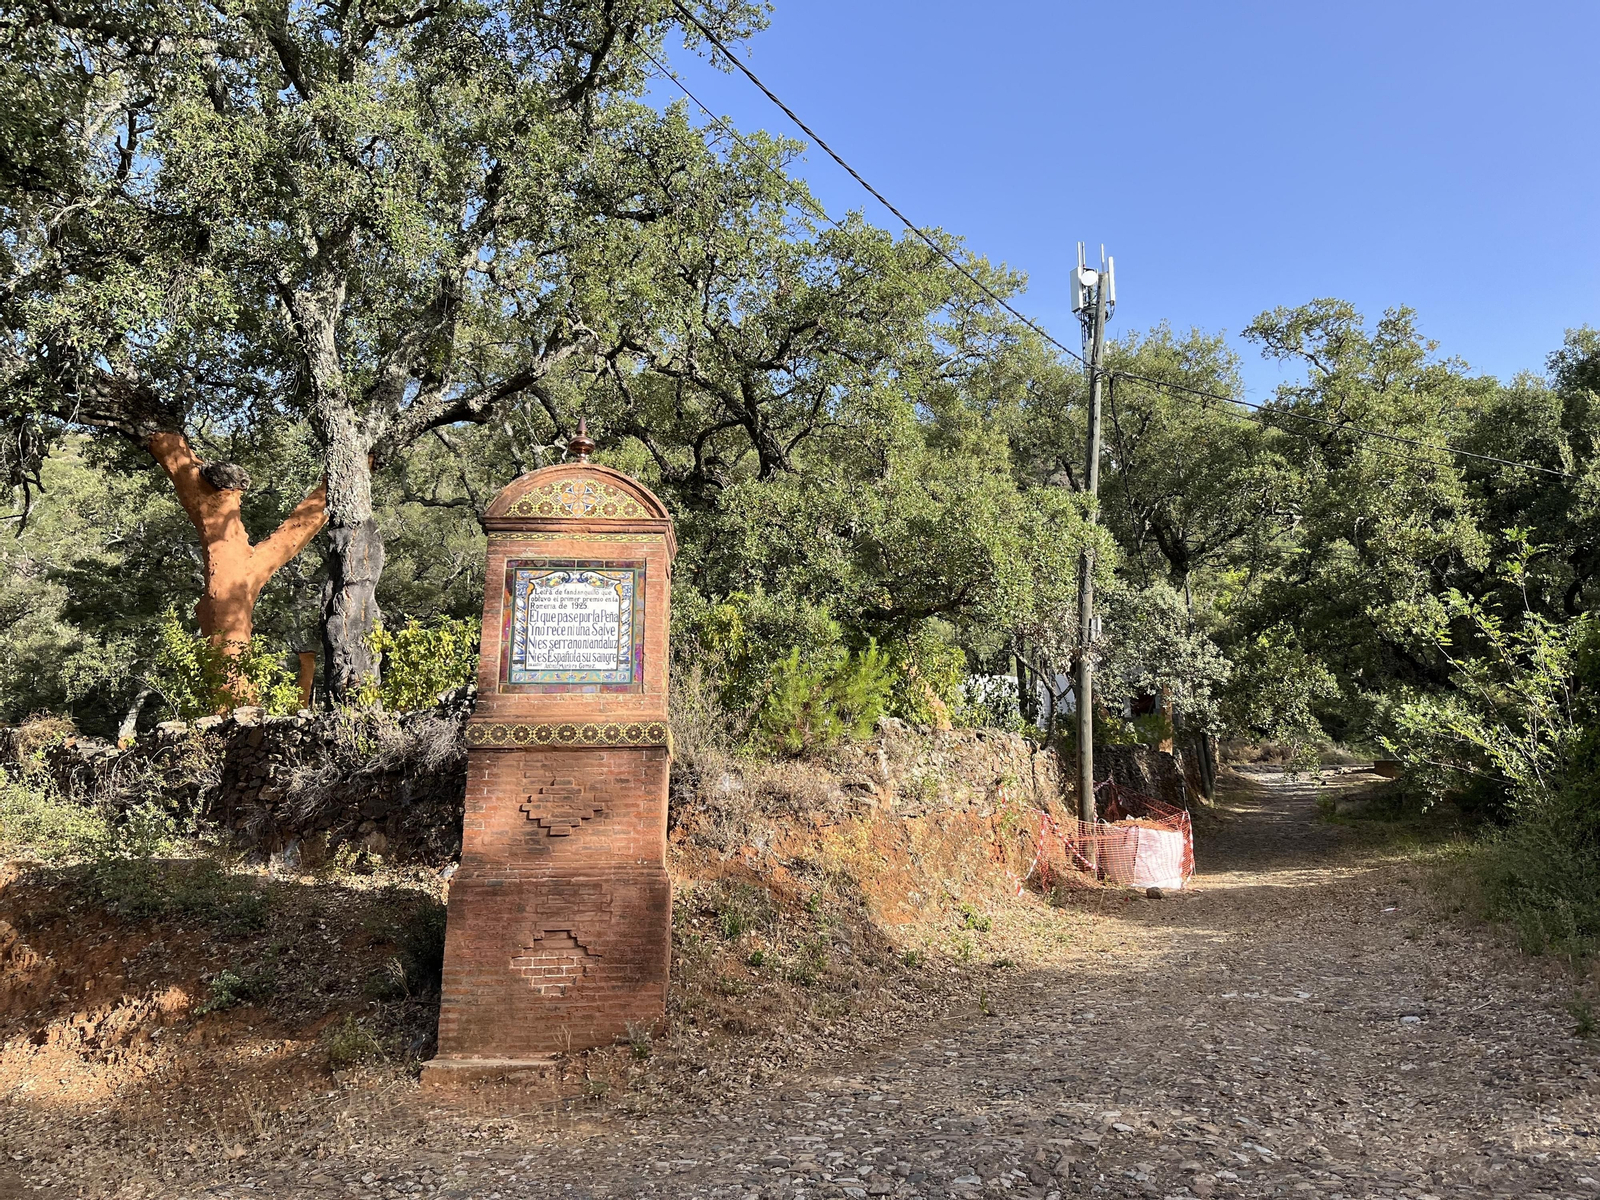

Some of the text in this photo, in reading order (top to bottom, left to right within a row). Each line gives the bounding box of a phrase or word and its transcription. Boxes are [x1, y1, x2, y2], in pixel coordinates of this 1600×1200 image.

[530, 609, 618, 626] El que pase por la Peña
[547, 626, 566, 636] rece
[567, 625, 575, 636] ni
[576, 626, 590, 636] una
[591, 622, 616, 636] Salve
[538, 639, 548, 649] es
[549, 639, 582, 649] serrano
[589, 636, 618, 649] andaluz
[537, 653, 547, 662] es
[547, 649, 581, 665] Española
[582, 653, 591, 662] su
[592, 653, 617, 665] sangre
